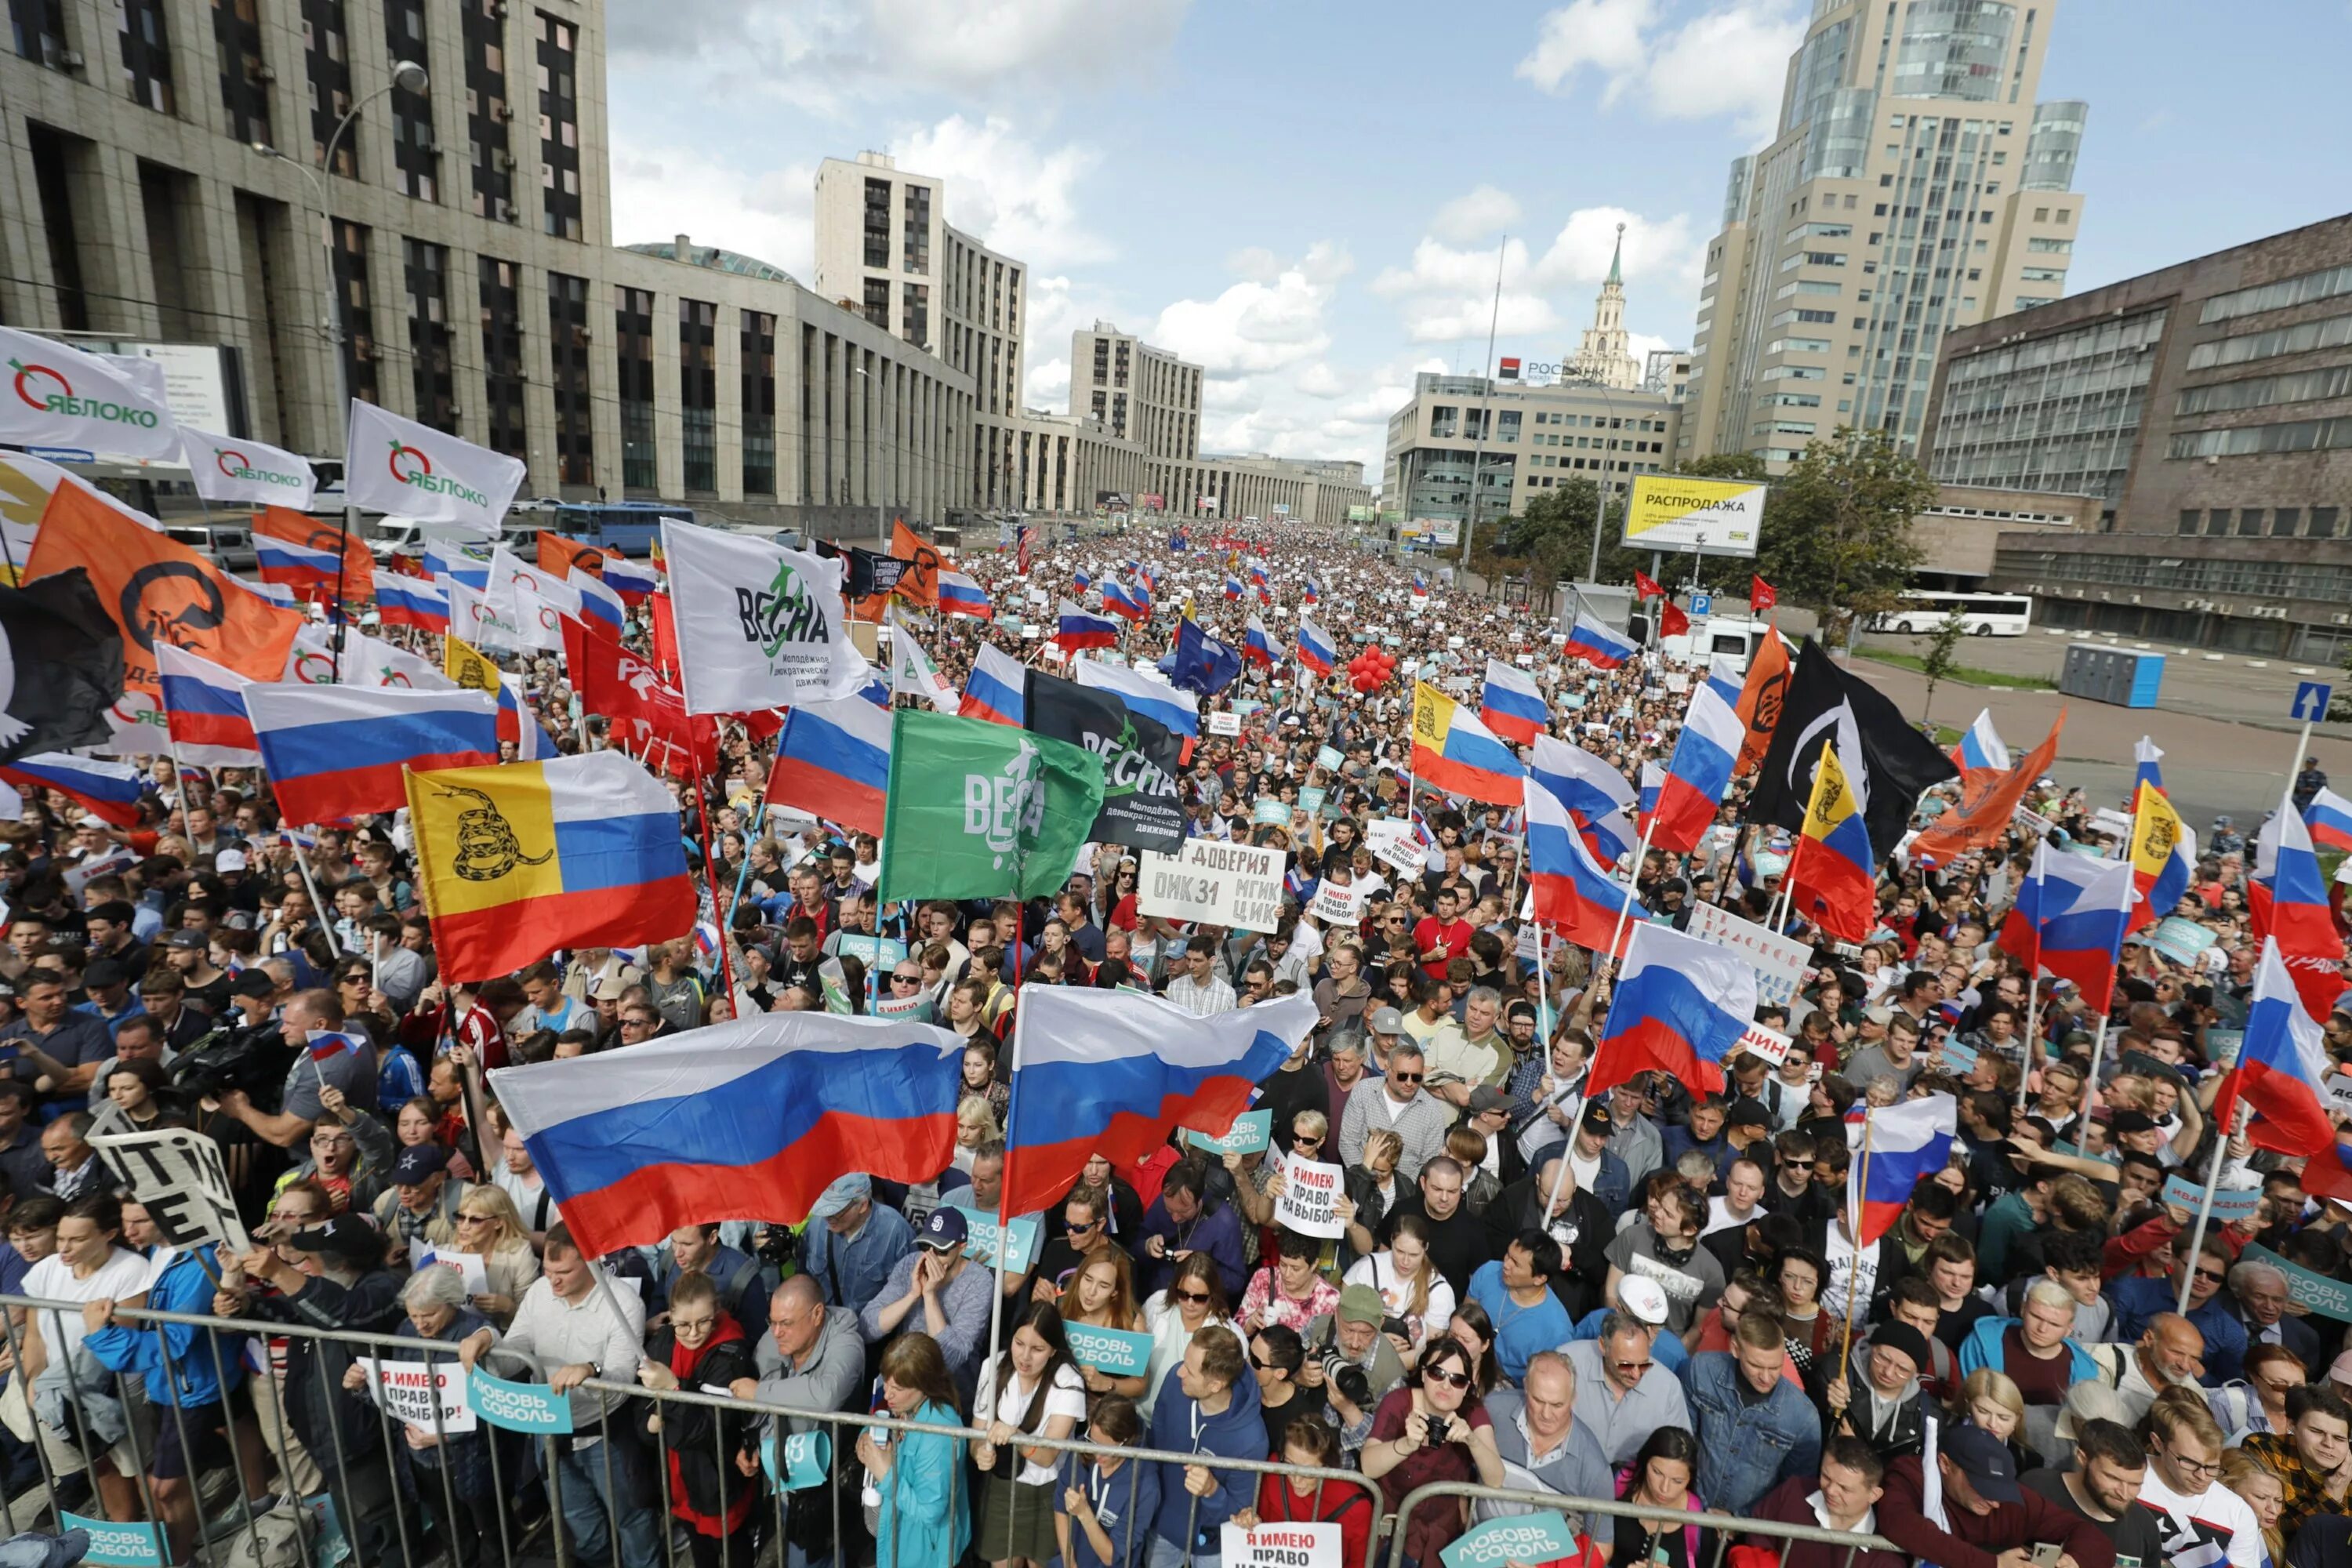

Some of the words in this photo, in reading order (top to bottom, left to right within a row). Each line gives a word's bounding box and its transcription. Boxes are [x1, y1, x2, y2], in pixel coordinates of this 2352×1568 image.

[45, 394, 157, 428] ЯБЛОКО
[232, 466, 301, 488] ЯБЛОКО
[406, 470, 488, 508] ЯБЛОКО
[1646, 494, 1745, 512] РАСПРОДАЖА
[1695, 597, 1707, 612] P
[735, 586, 829, 644] ВЕСНА
[1135, 823, 1179, 838] движение
[1382, 848, 1391, 857] НА
[1392, 844, 1414, 860] ПРАВО
[1399, 839, 1421, 855] ИМЕЮ
[1191, 845, 1270, 876] ДОВЕРИЯ
[1153, 872, 1194, 902] ОИК
[1195, 879, 1219, 906] 31
[1236, 878, 1280, 902] МГИК
[1328, 889, 1352, 901] ИМЕЮ
[1232, 899, 1276, 924] ЦИК
[1316, 902, 1325, 911] НА
[1325, 906, 1355, 919] ВЫБОР!
[1323, 896, 1348, 909] ПРАВО
[848, 941, 894, 954] ЛЮБВЬ
[854, 952, 896, 964] ОБЛЬ
[1229, 1122, 1257, 1134] ОВЬ
[1294, 1166, 1300, 1179] Я
[1301, 1169, 1334, 1189] ИМЕЮ
[1294, 1184, 1329, 1205] ПРАВО
[1283, 1196, 1294, 1213] НА
[1294, 1202, 1338, 1225] ВЫБОР!
[2291, 1287, 2350, 1313] БОЛЬ
[1066, 1333, 1133, 1353] ЮБОВЬ
[1073, 1347, 1136, 1367] ОБОЛЬ
[381, 1370, 390, 1384] Я
[472, 1375, 548, 1408] ЛЮБОВЬ
[481, 1398, 557, 1423] СОБОЛЬ
[88, 1542, 157, 1558] ОБОЛЬ
[1247, 1533, 1257, 1545] Я
[1261, 1533, 1316, 1548] ИМЕЮ
[1459, 1526, 1548, 1562] ЛЮБОВЬ
[1253, 1548, 1309, 1566] ПРАВО
[1475, 1539, 1560, 1563] СОБОЛЬ
